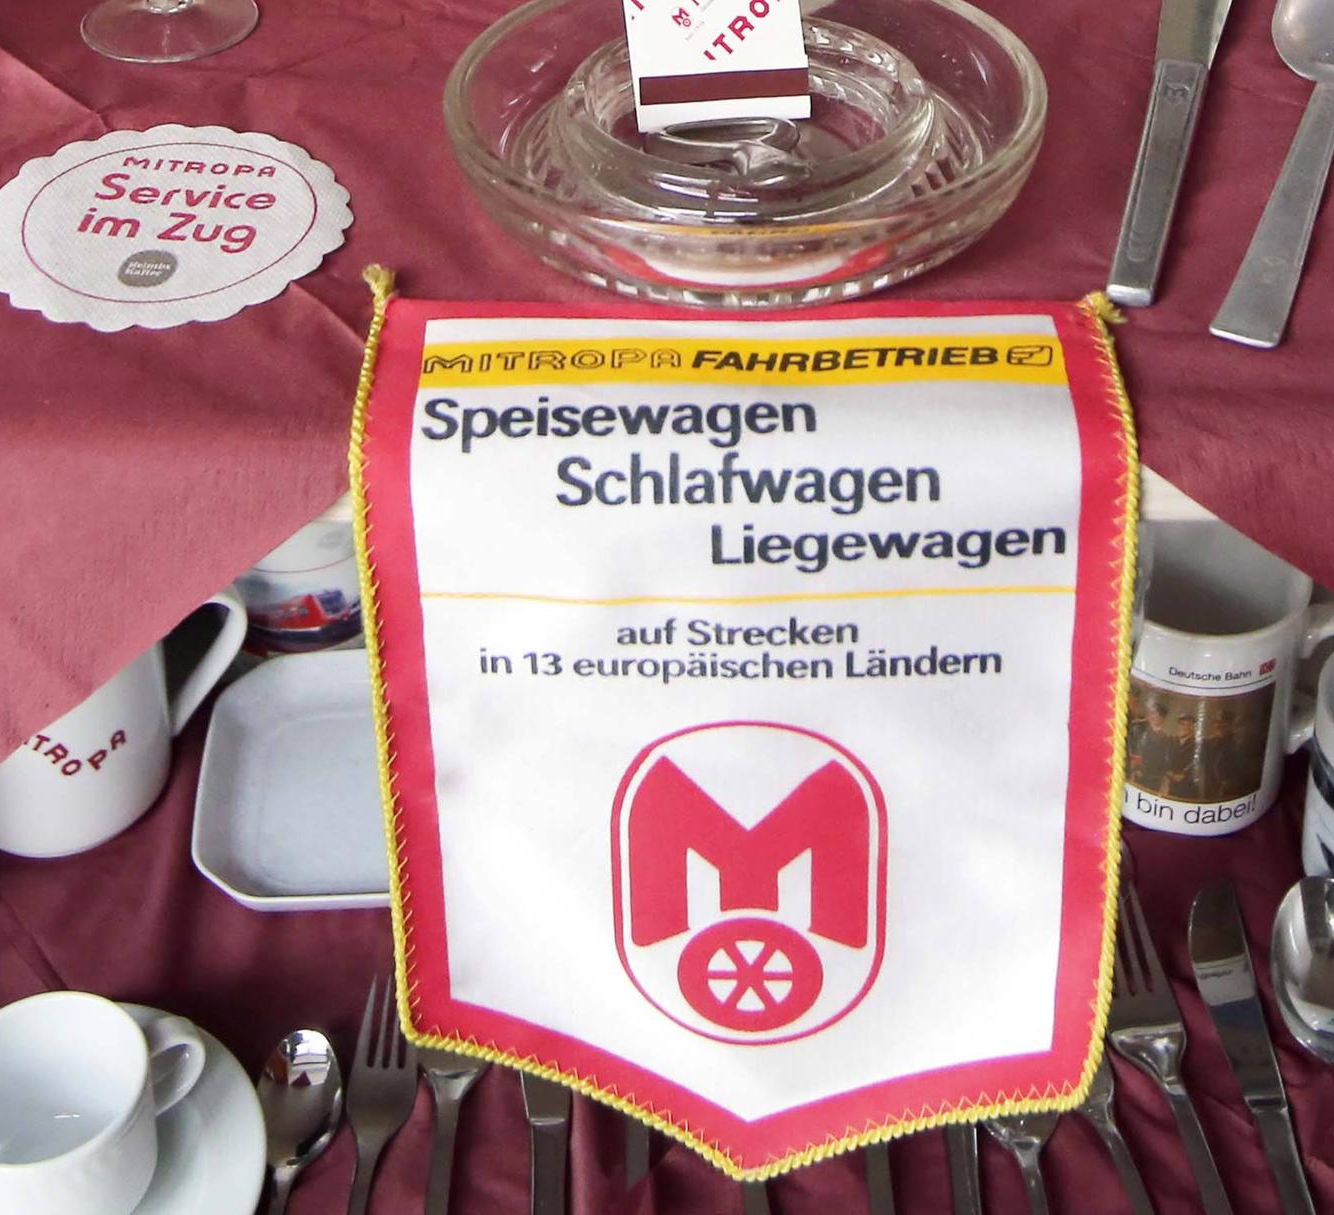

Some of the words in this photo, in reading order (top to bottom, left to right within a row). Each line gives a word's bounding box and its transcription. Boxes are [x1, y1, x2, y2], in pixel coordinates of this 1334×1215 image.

[122, 156, 278, 178] MITROPA
[94, 172, 277, 210] Service
[76, 207, 140, 240] im
[157, 212, 258, 254] Zug
[422, 347, 682, 374] MITROPA
[691, 345, 999, 373] FAHRBETRIEB
[421, 396, 817, 453] Speisewagen
[555, 452, 941, 514] Schlafwagen
[710, 524, 1067, 573] Liegewagen
[615, 619, 676, 646] auf
[686, 619, 859, 646] Strecken
[479, 647, 513, 674] in
[521, 651, 563, 675] 13
[573, 647, 834, 684] europäischen
[845, 647, 1003, 677] Ländern
[1169, 666, 1222, 682] Deutsche
[1225, 670, 1252, 681] Bahn
[24, 729, 127, 776] TROPA
[1137, 792, 1174, 821] bin
[1184, 794, 1258, 825] dabei!
